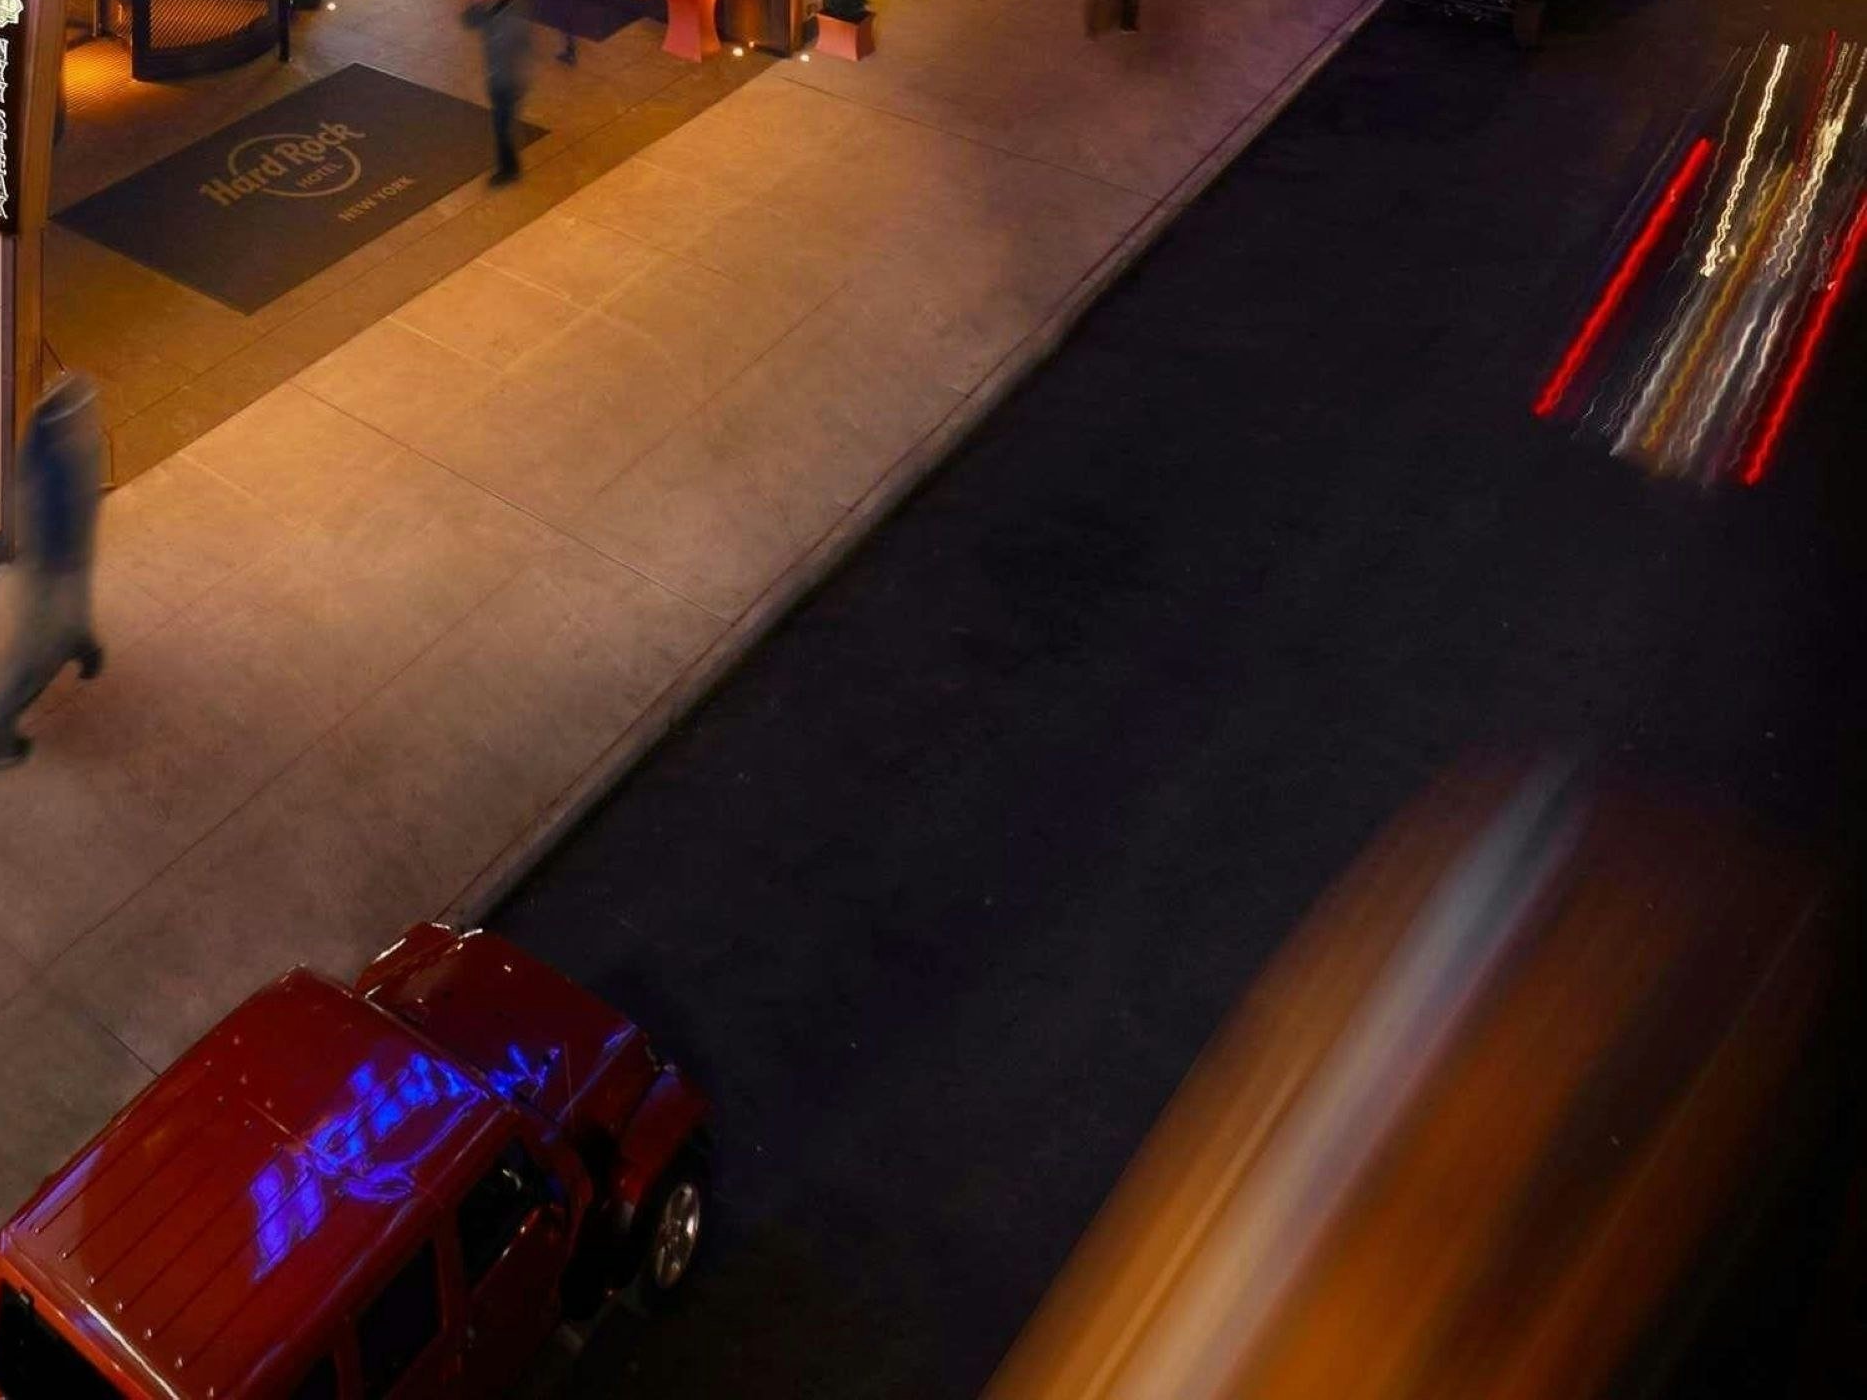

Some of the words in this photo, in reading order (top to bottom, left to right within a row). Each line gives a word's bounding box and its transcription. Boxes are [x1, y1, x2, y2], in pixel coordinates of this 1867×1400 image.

[198, 154, 288, 206] Hard
[273, 120, 366, 166] Rock
[295, 161, 344, 189] HOTEL
[338, 197, 378, 222] NEW
[374, 175, 416, 201] YORK
